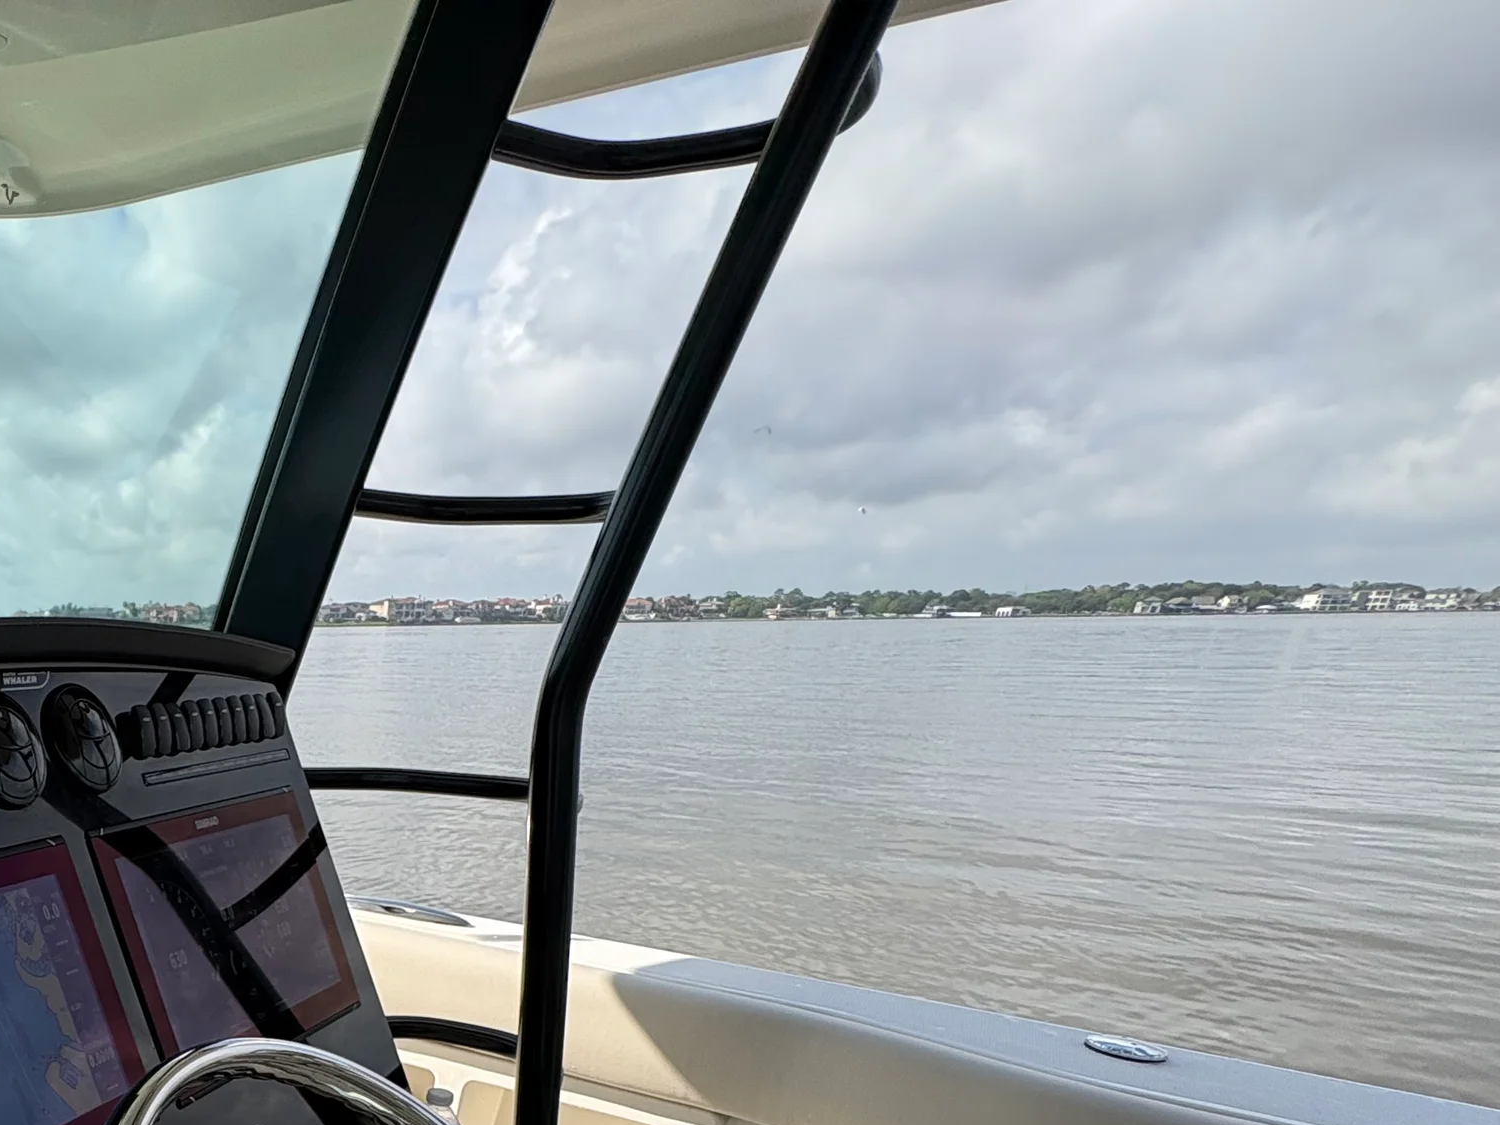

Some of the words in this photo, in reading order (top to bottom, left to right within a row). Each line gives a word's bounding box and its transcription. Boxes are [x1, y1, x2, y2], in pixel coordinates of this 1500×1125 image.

[3, 676, 37, 685] WHALER
[43, 903, 60, 920] 0.0
[169, 949, 188, 969] 630
